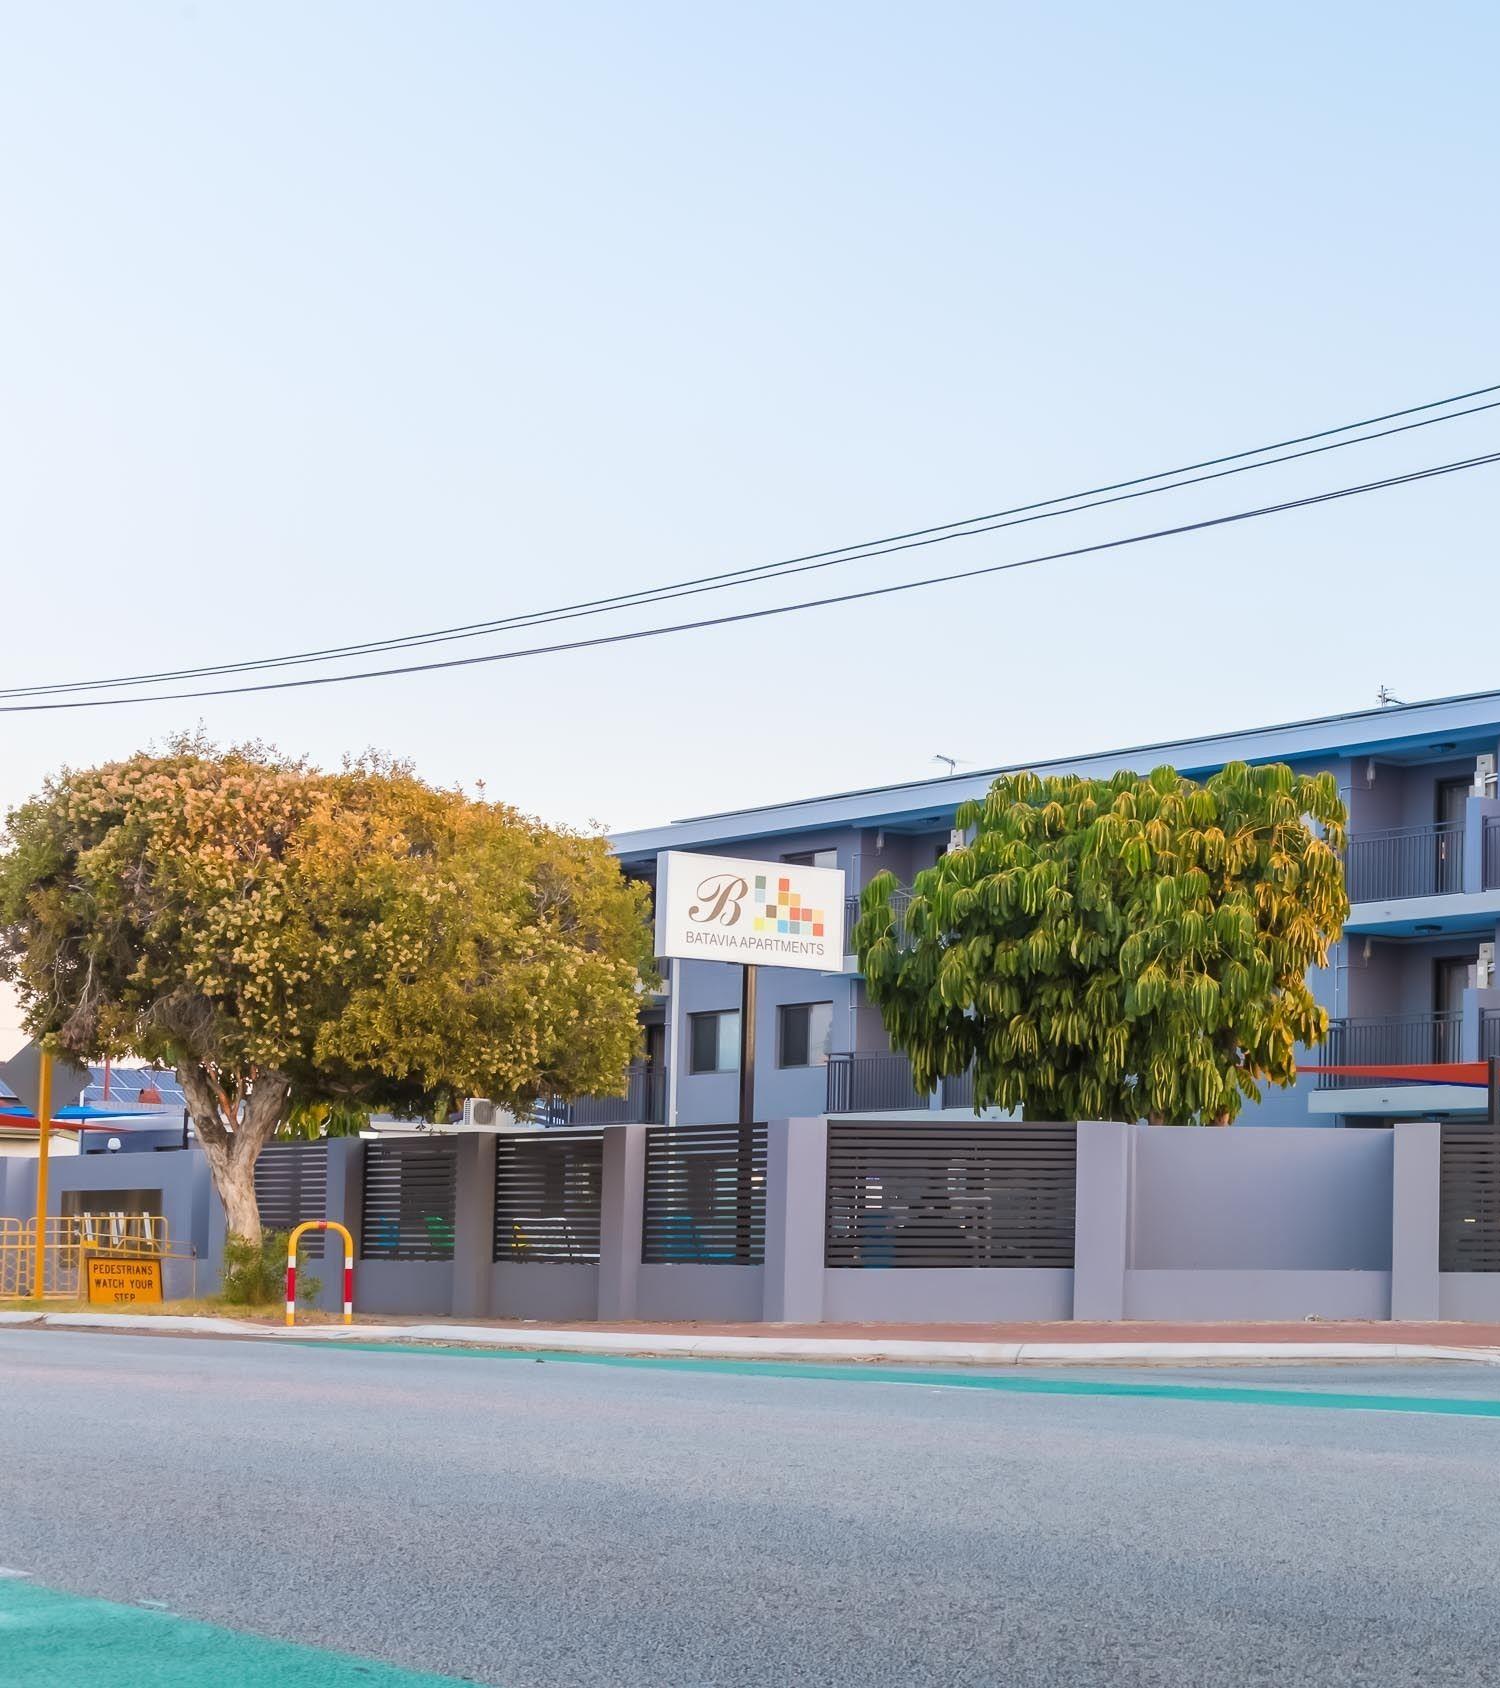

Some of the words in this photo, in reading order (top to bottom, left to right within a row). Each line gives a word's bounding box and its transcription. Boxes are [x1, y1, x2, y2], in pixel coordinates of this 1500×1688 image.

[686, 931, 738, 949] BATAVIA
[740, 935, 825, 956] APARTMENTS
[93, 1263, 153, 1275] PEDESTRIANS
[94, 1278, 124, 1289] WATCH
[129, 1280, 153, 1289] YOUR
[113, 1292, 136, 1304] STEP
